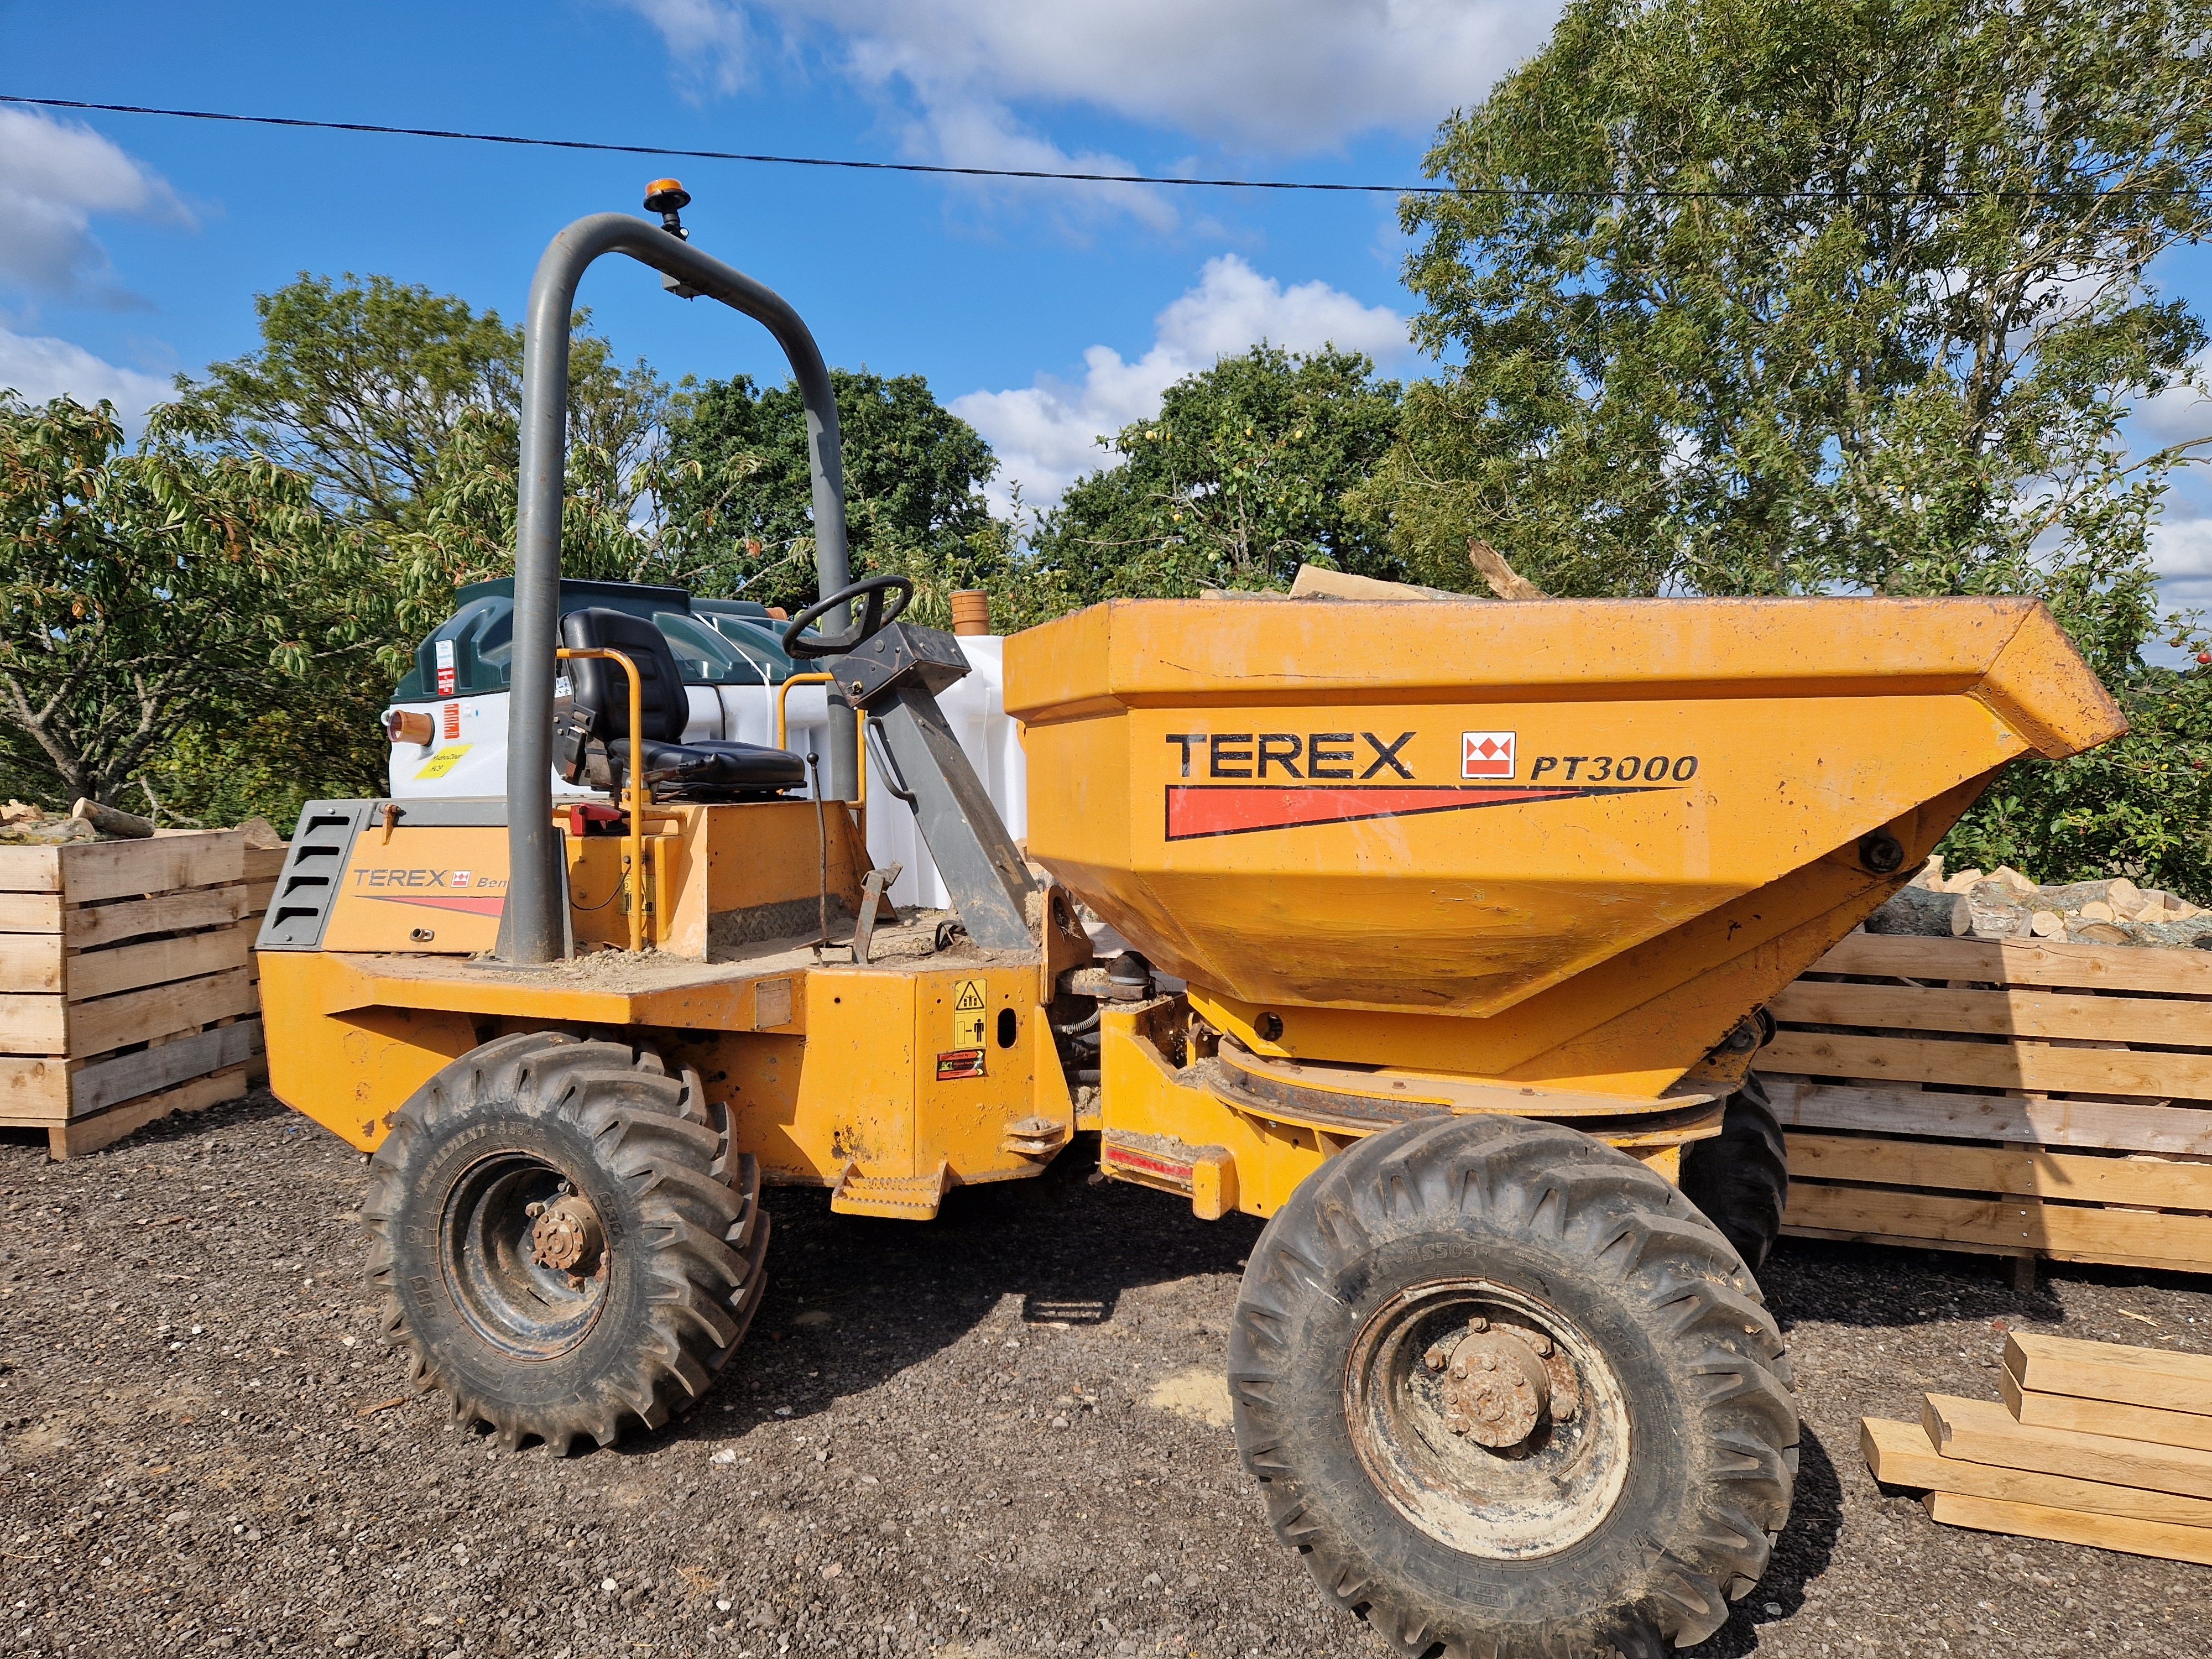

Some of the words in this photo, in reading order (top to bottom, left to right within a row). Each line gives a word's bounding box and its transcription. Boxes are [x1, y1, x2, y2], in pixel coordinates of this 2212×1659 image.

[1166, 731, 1416, 780] TEREX
[1530, 755, 1699, 782] PT3000
[353, 869, 450, 887] TEREX
